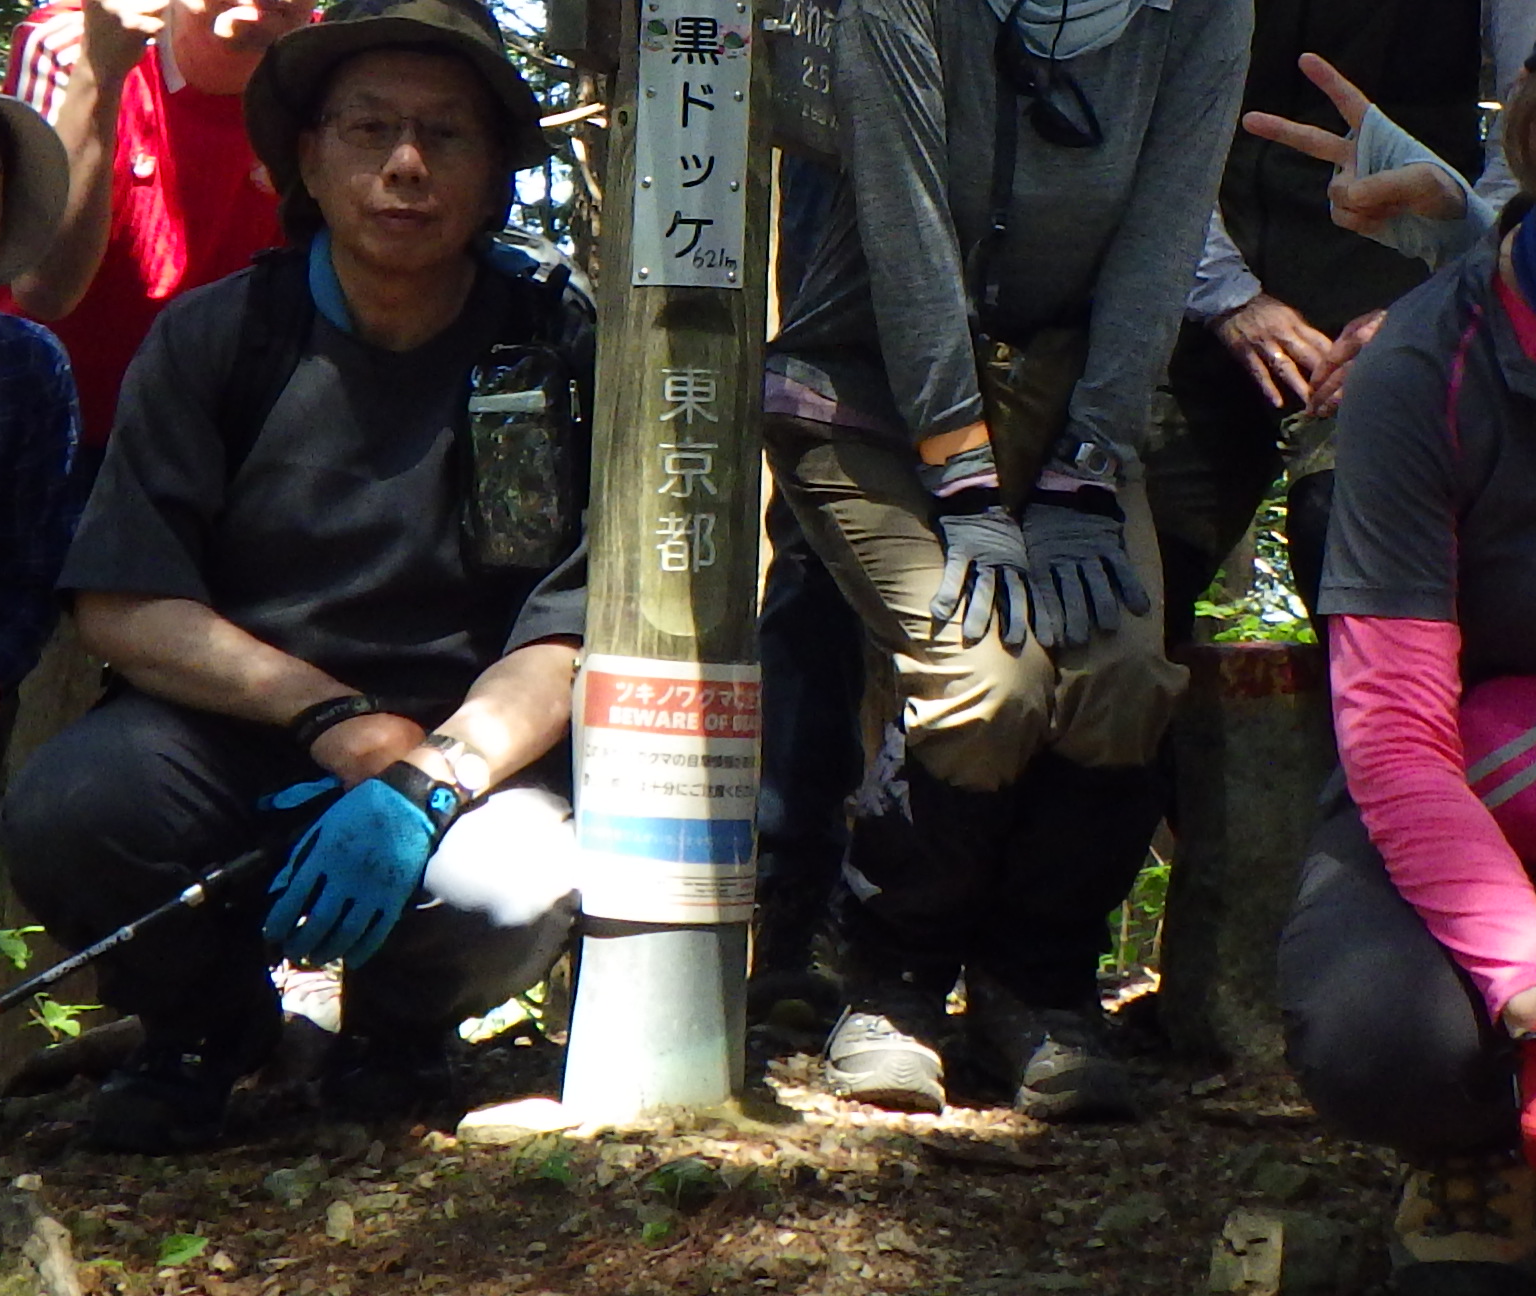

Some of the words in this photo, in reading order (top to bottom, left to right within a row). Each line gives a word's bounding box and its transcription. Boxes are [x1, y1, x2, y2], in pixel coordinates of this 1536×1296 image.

[654, 363, 720, 573] 東京都
[608, 705, 700, 731] BEWARE
[704, 713, 728, 732] OF
